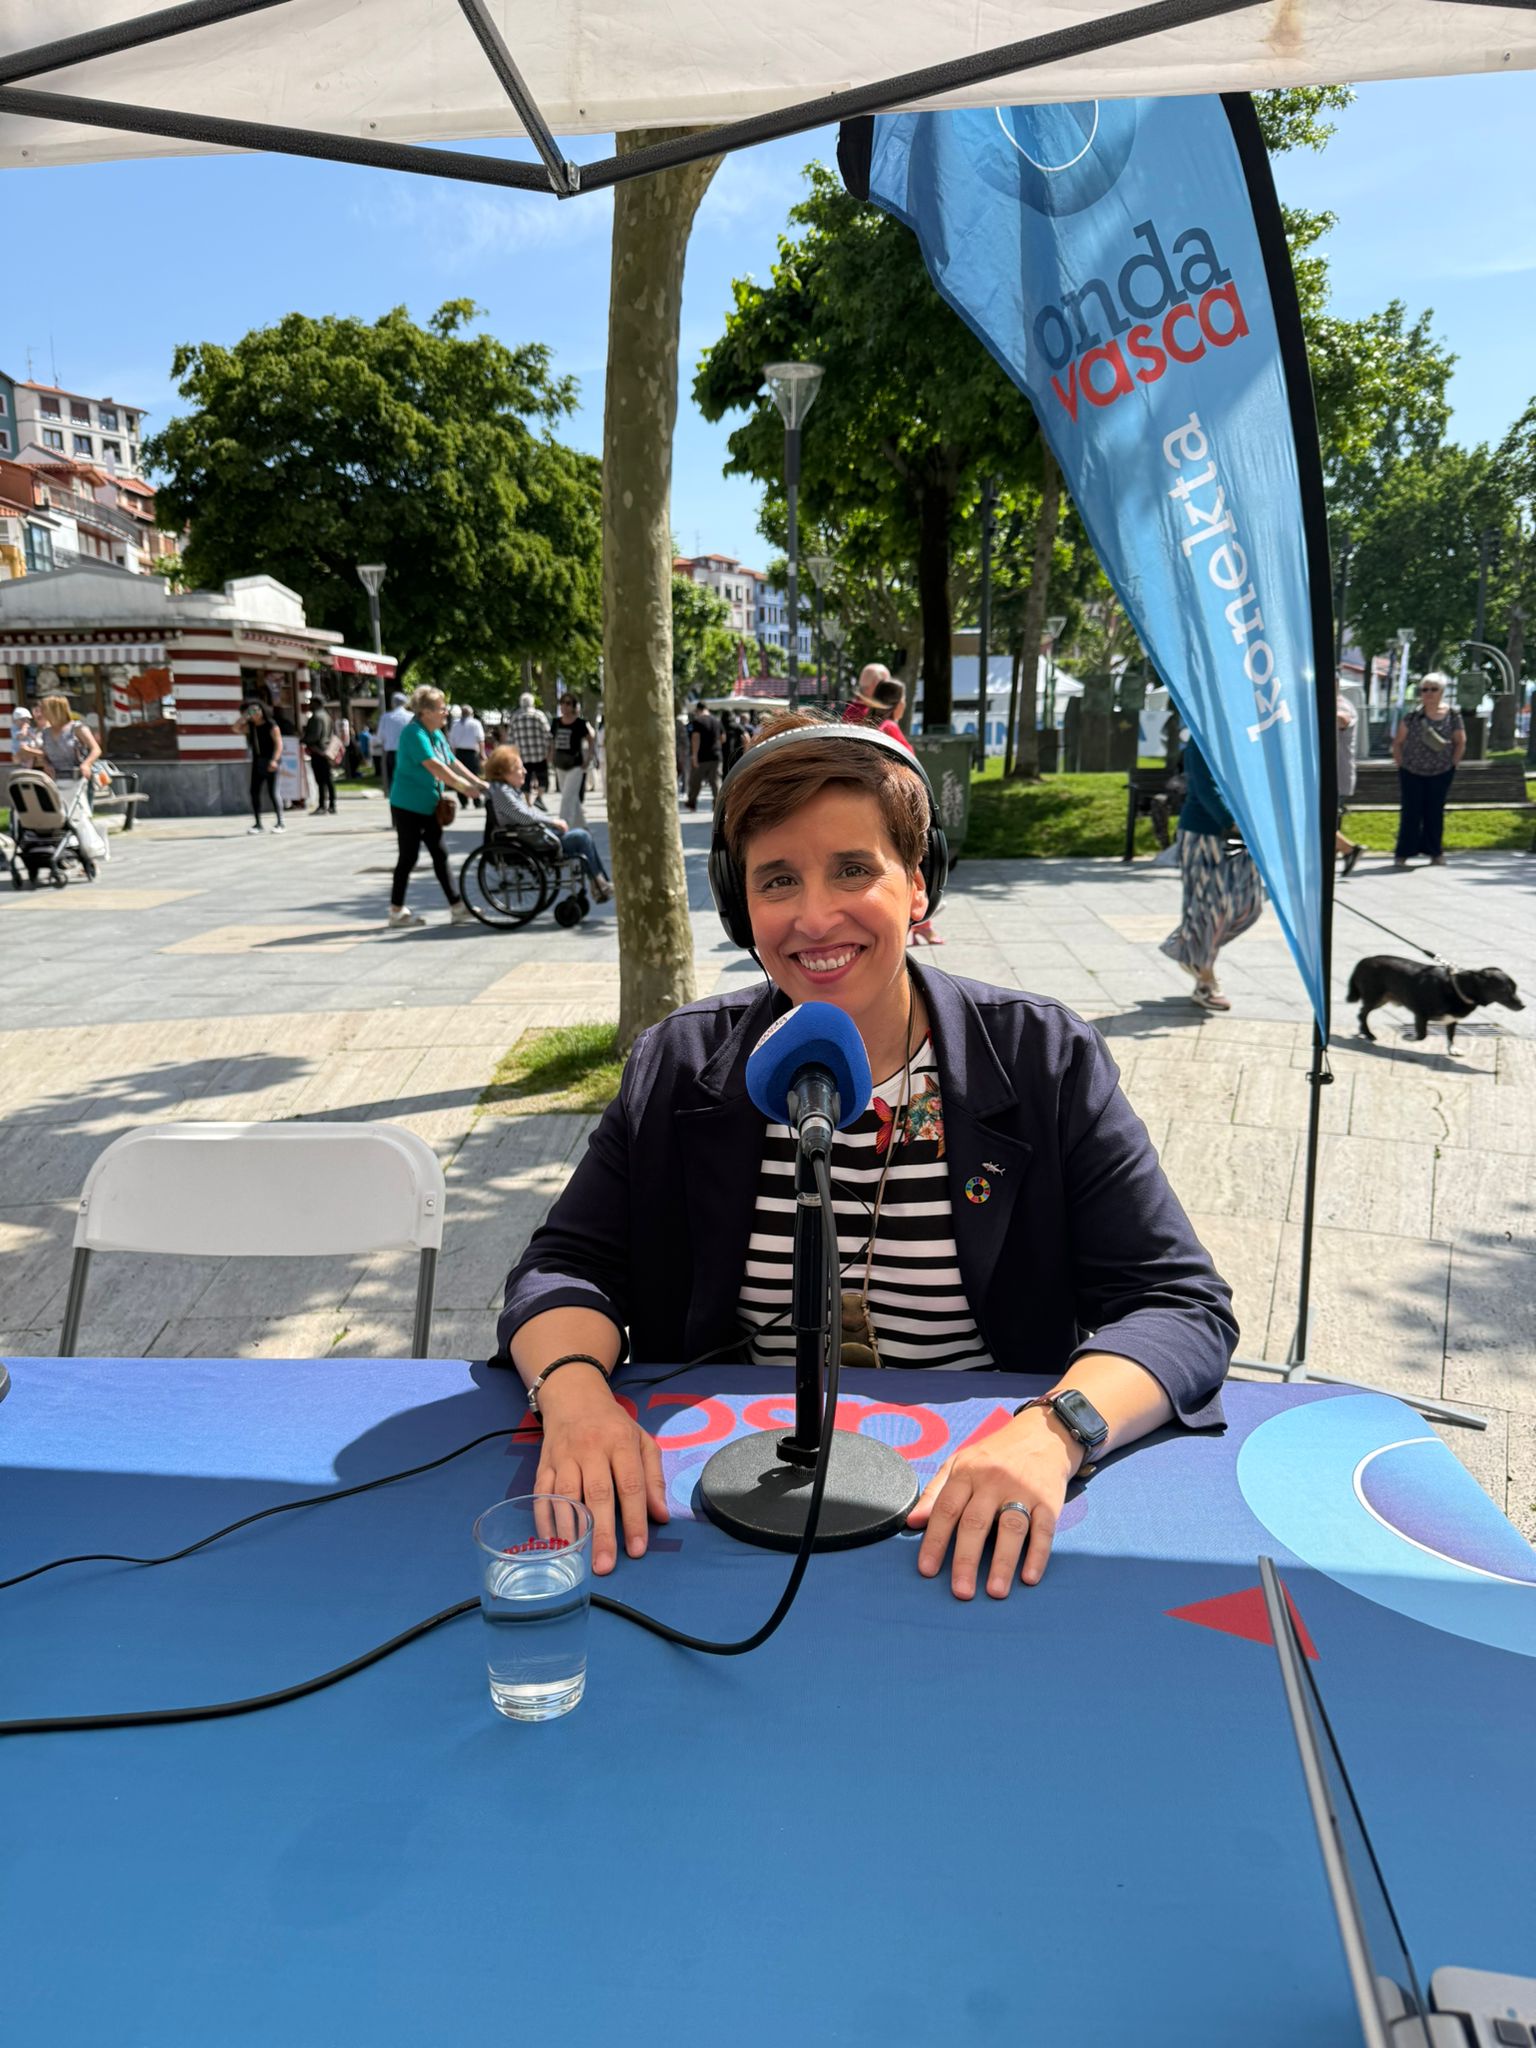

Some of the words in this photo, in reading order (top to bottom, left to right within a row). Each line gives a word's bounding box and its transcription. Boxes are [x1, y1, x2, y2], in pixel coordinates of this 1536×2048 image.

[1033, 219, 1232, 370] onda
[1051, 281, 1249, 422] vasca
[1163, 411, 1292, 742] konekta
